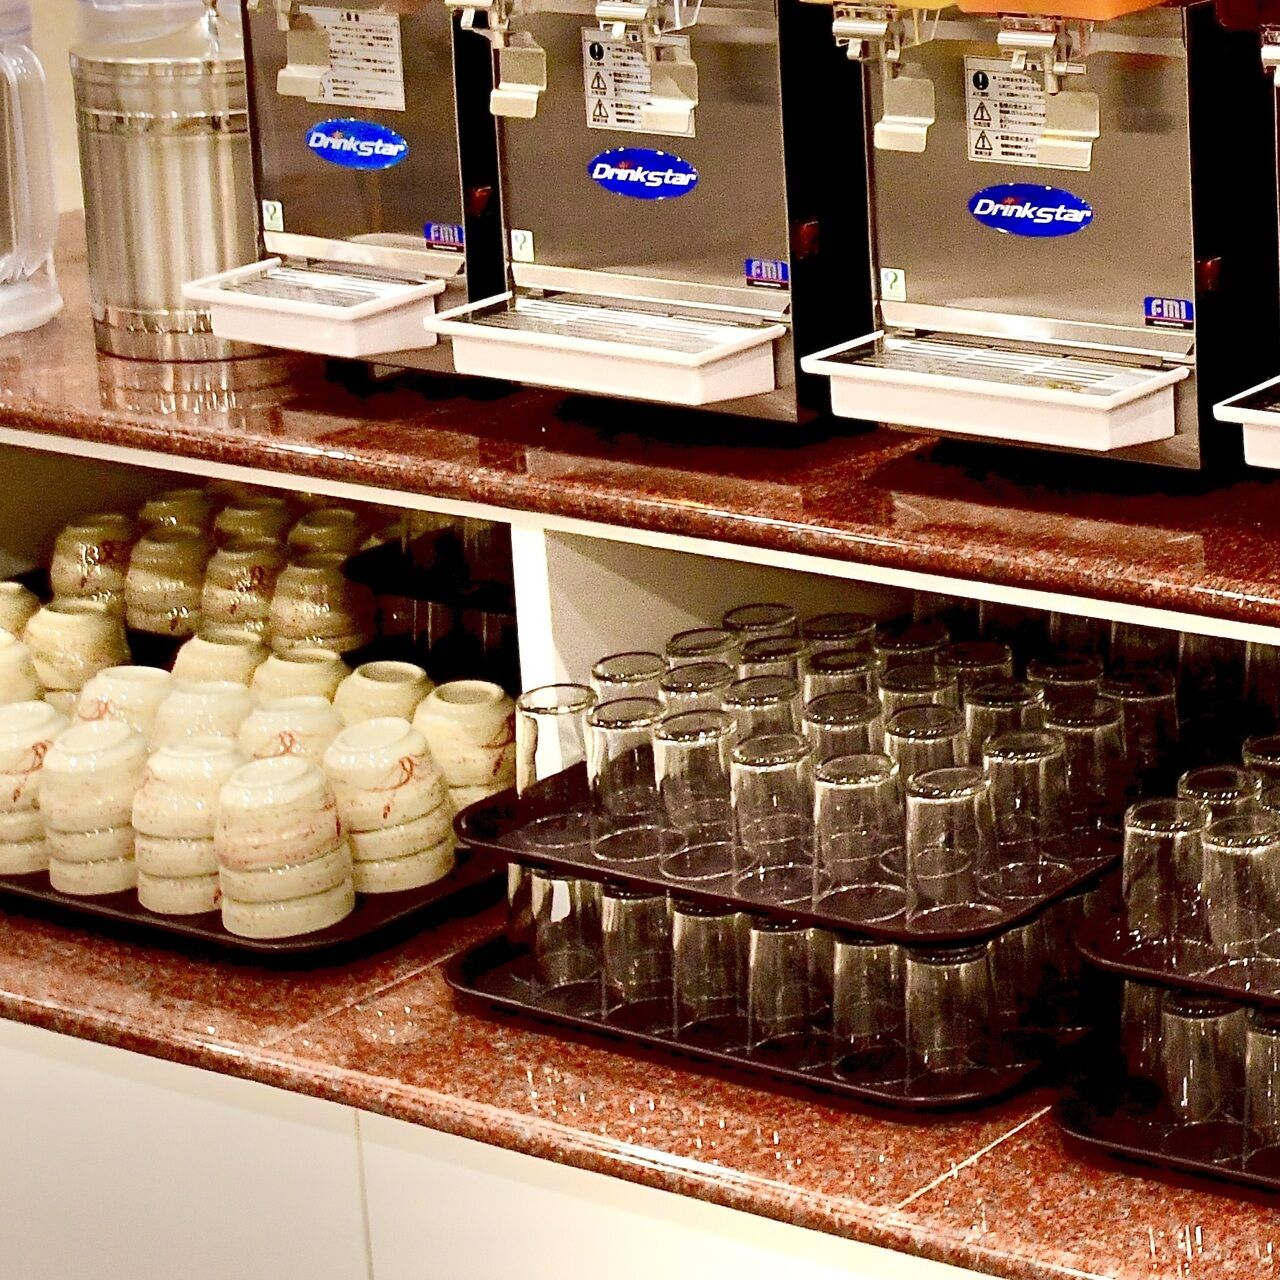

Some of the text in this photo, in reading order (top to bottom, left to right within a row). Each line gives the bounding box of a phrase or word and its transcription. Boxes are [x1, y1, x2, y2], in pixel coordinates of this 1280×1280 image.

[309, 131, 405, 157] Drinkstar
[592, 163, 697, 187] Drinkstar
[973, 199, 1092, 223] Drinkstar
